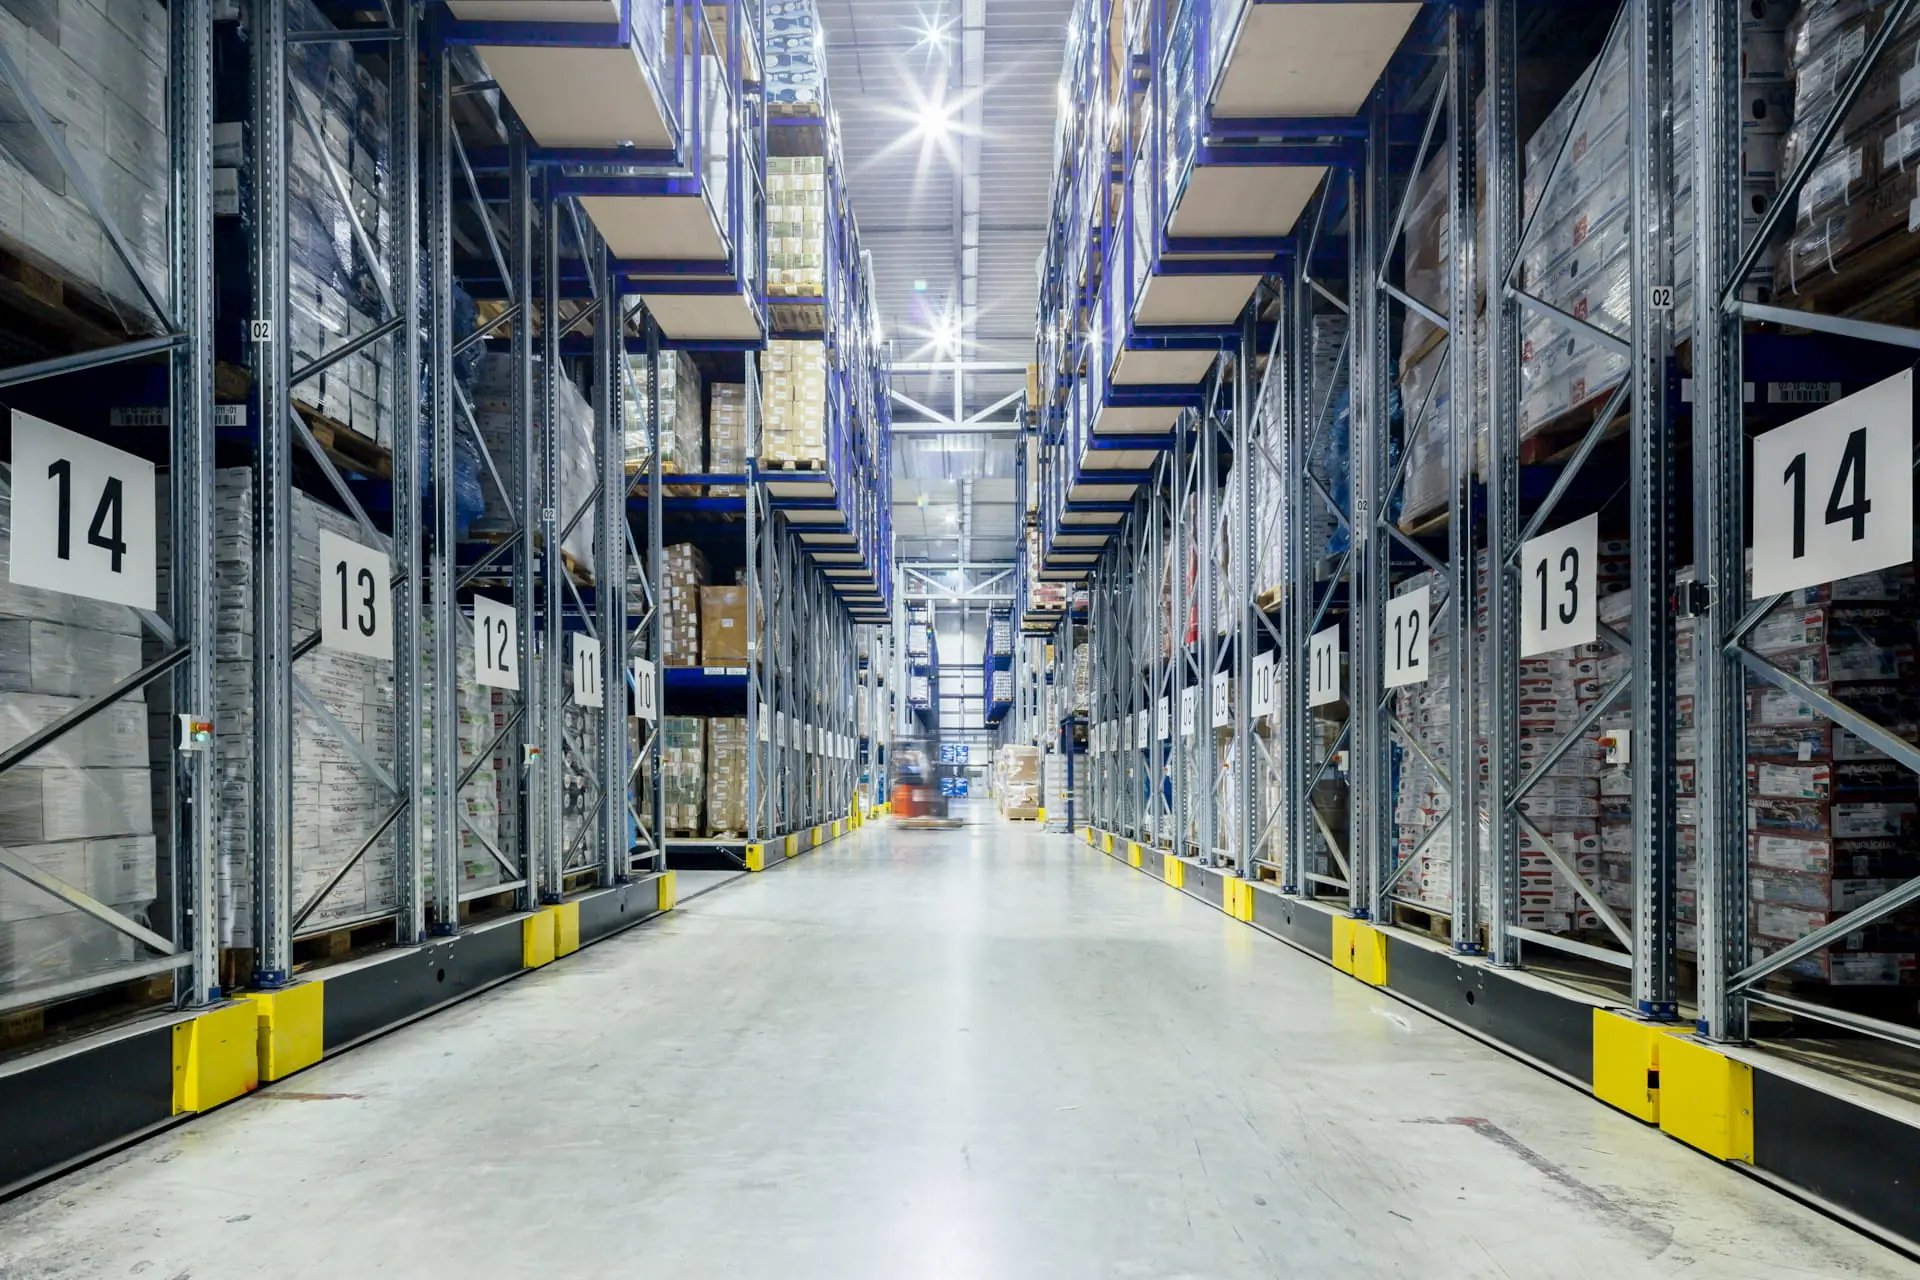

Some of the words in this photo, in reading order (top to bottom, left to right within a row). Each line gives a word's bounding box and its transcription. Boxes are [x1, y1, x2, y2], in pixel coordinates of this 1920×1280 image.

[1652, 288, 1670, 306] 02
[253, 322, 269, 338] 02
[47, 458, 127, 574] 14
[543, 510, 554, 519] 02
[1357, 500, 1368, 511] 02
[1783, 426, 1872, 560] 14
[336, 560, 376, 637] 13
[1536, 546, 1579, 632] 13
[483, 615, 509, 673] 12
[1394, 608, 1420, 671] 12
[578, 649, 594, 695] 11
[638, 671, 651, 710] 10
[1255, 664, 1270, 706] 10
[1315, 643, 1332, 693] 11
[1215, 682, 1226, 719] 09
